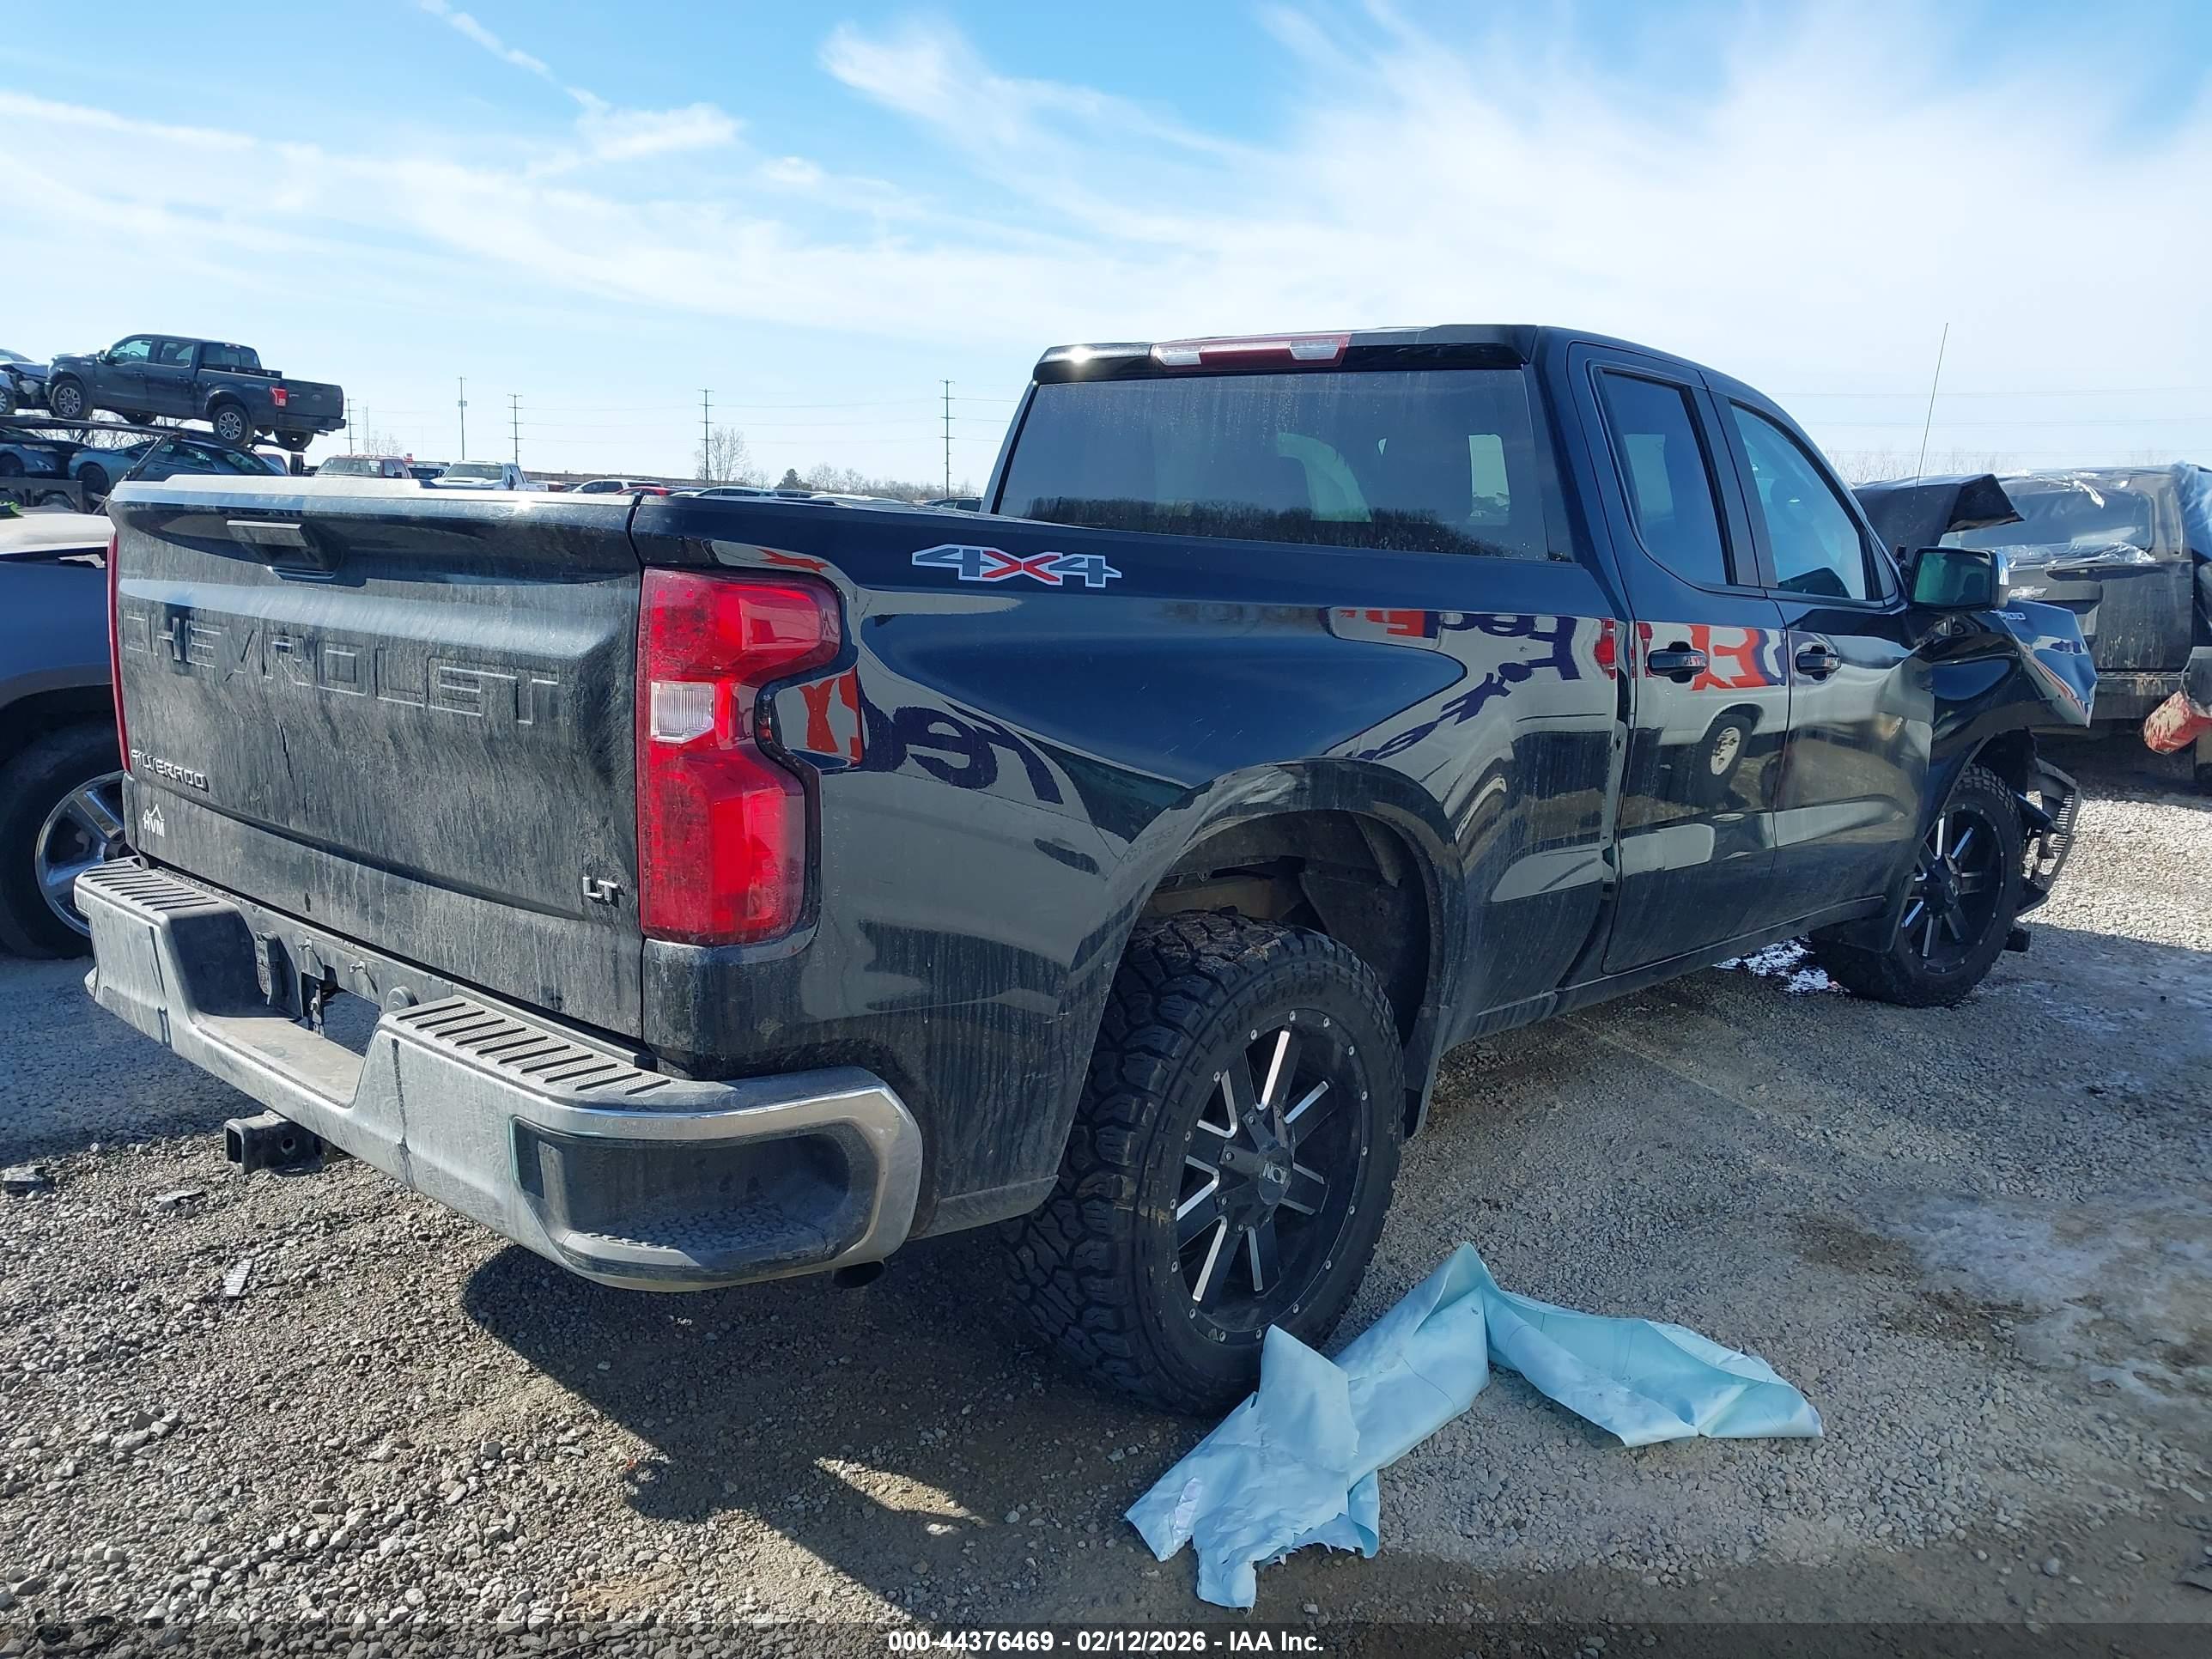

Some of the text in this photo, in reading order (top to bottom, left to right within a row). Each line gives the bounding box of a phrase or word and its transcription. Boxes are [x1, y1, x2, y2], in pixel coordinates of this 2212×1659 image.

[122, 610, 560, 725] CHEVROLET
[131, 749, 209, 792] SILVERADO
[583, 877, 619, 902] LT
